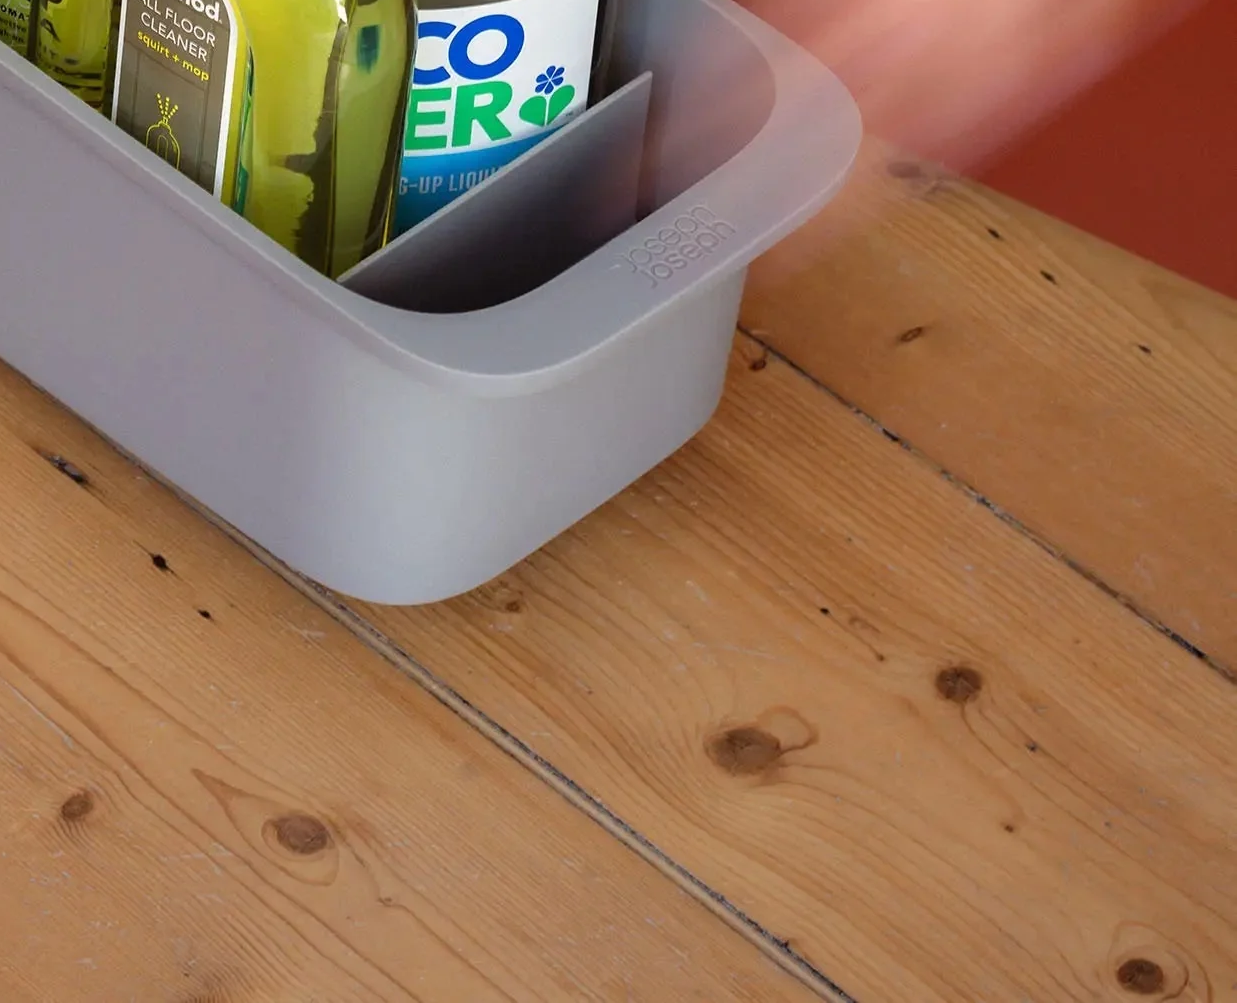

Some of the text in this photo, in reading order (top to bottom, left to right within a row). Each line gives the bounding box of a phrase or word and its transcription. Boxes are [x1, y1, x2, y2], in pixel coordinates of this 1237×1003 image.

[141, 12, 208, 63] CLEANER
[165, 7, 216, 48] FLOOR
[137, 30, 170, 59] squirt
[182, 59, 210, 82] mop
[404, 80, 513, 152] ER
